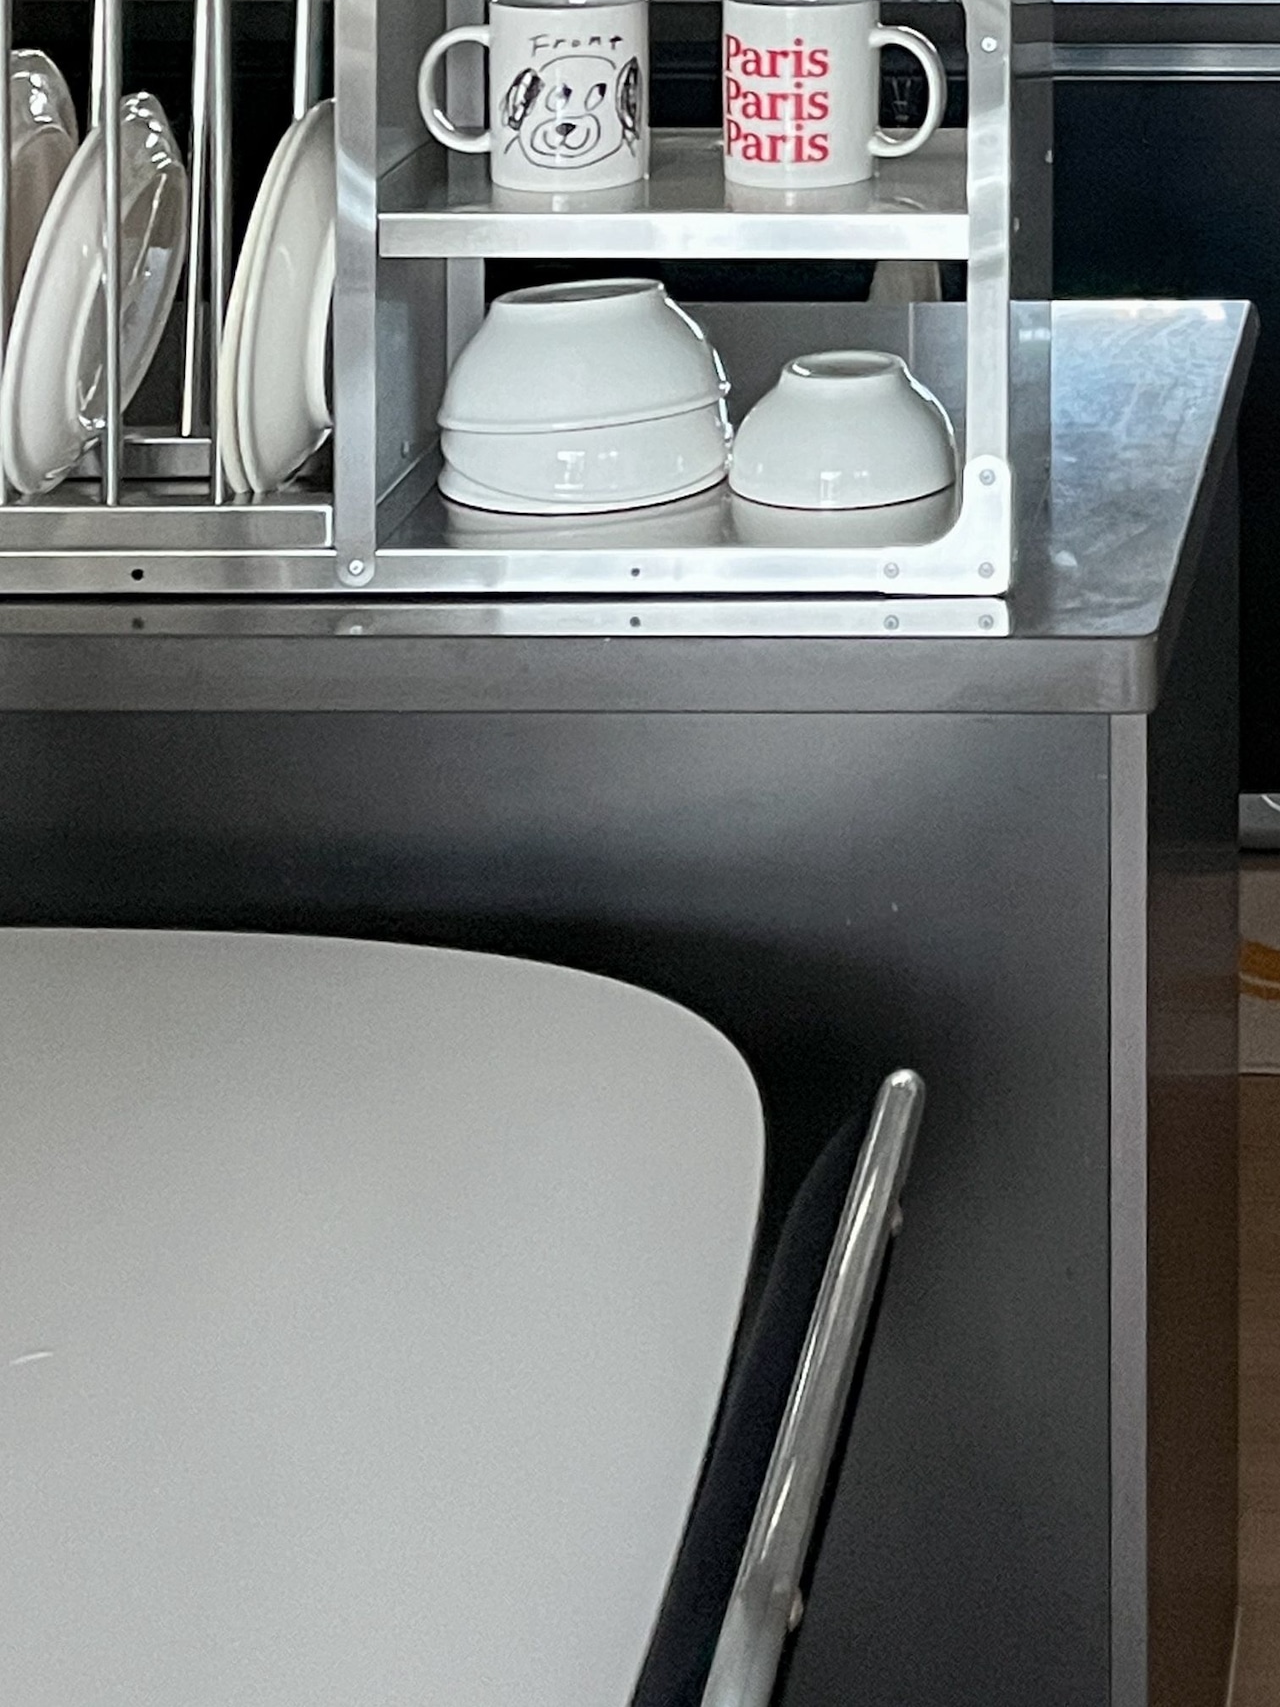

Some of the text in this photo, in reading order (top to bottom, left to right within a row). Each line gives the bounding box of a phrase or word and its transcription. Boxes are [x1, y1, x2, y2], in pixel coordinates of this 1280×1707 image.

[529, 34, 623, 57] Front
[725, 34, 829, 78] Paris
[726, 76, 829, 121] Paris
[726, 118, 829, 163] Paris
